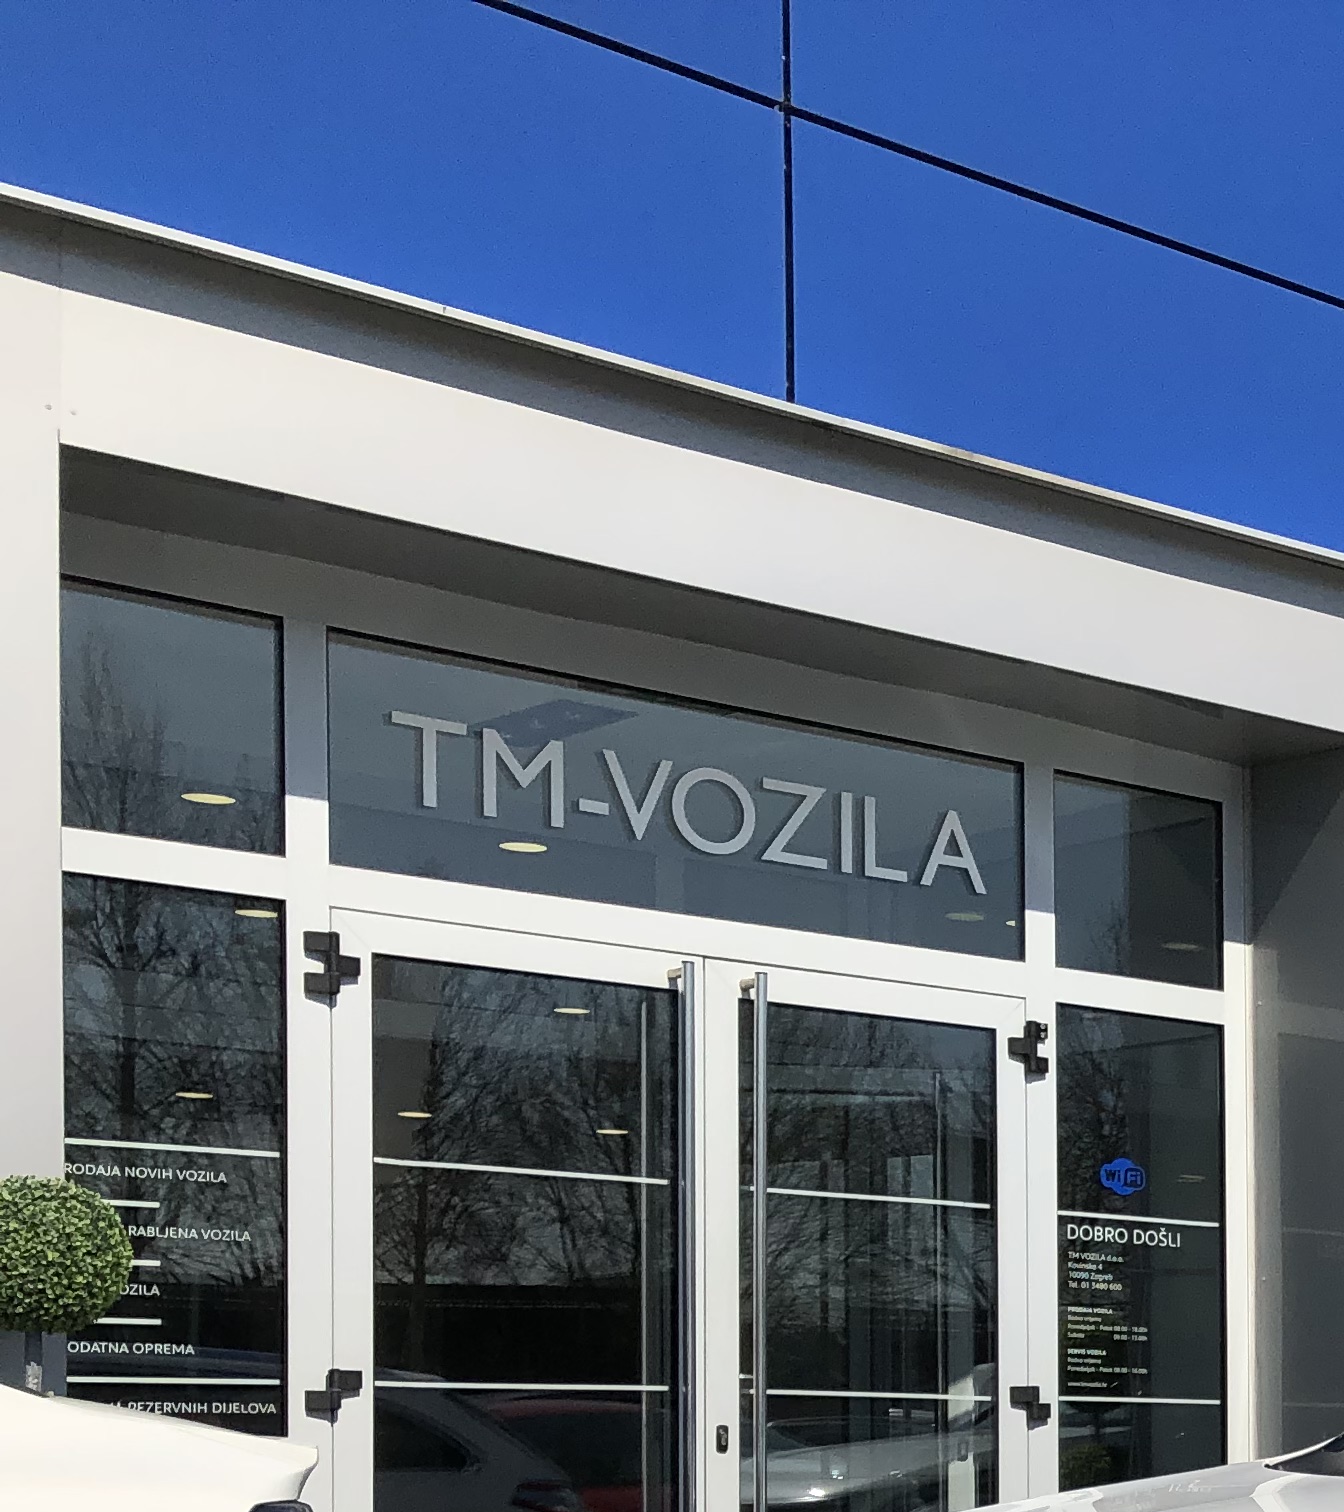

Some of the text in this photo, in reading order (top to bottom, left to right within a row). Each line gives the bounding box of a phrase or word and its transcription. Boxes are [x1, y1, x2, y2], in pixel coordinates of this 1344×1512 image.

[391, 711, 987, 895] TM-VOZILA
[64, 1163, 227, 1183] RODAJA NOVIH VOZILA
[128, 1226, 251, 1242] RABLJENA VOZILA
[1067, 1224, 1181, 1248] DOBRO DOŠLI
[1080, 1252, 1106, 1261] VOZILA
[119, 1284, 160, 1297] OZILA
[67, 1341, 195, 1355] ODATNA OPREMA
[212, 1402, 276, 1415] DIJELOVA
